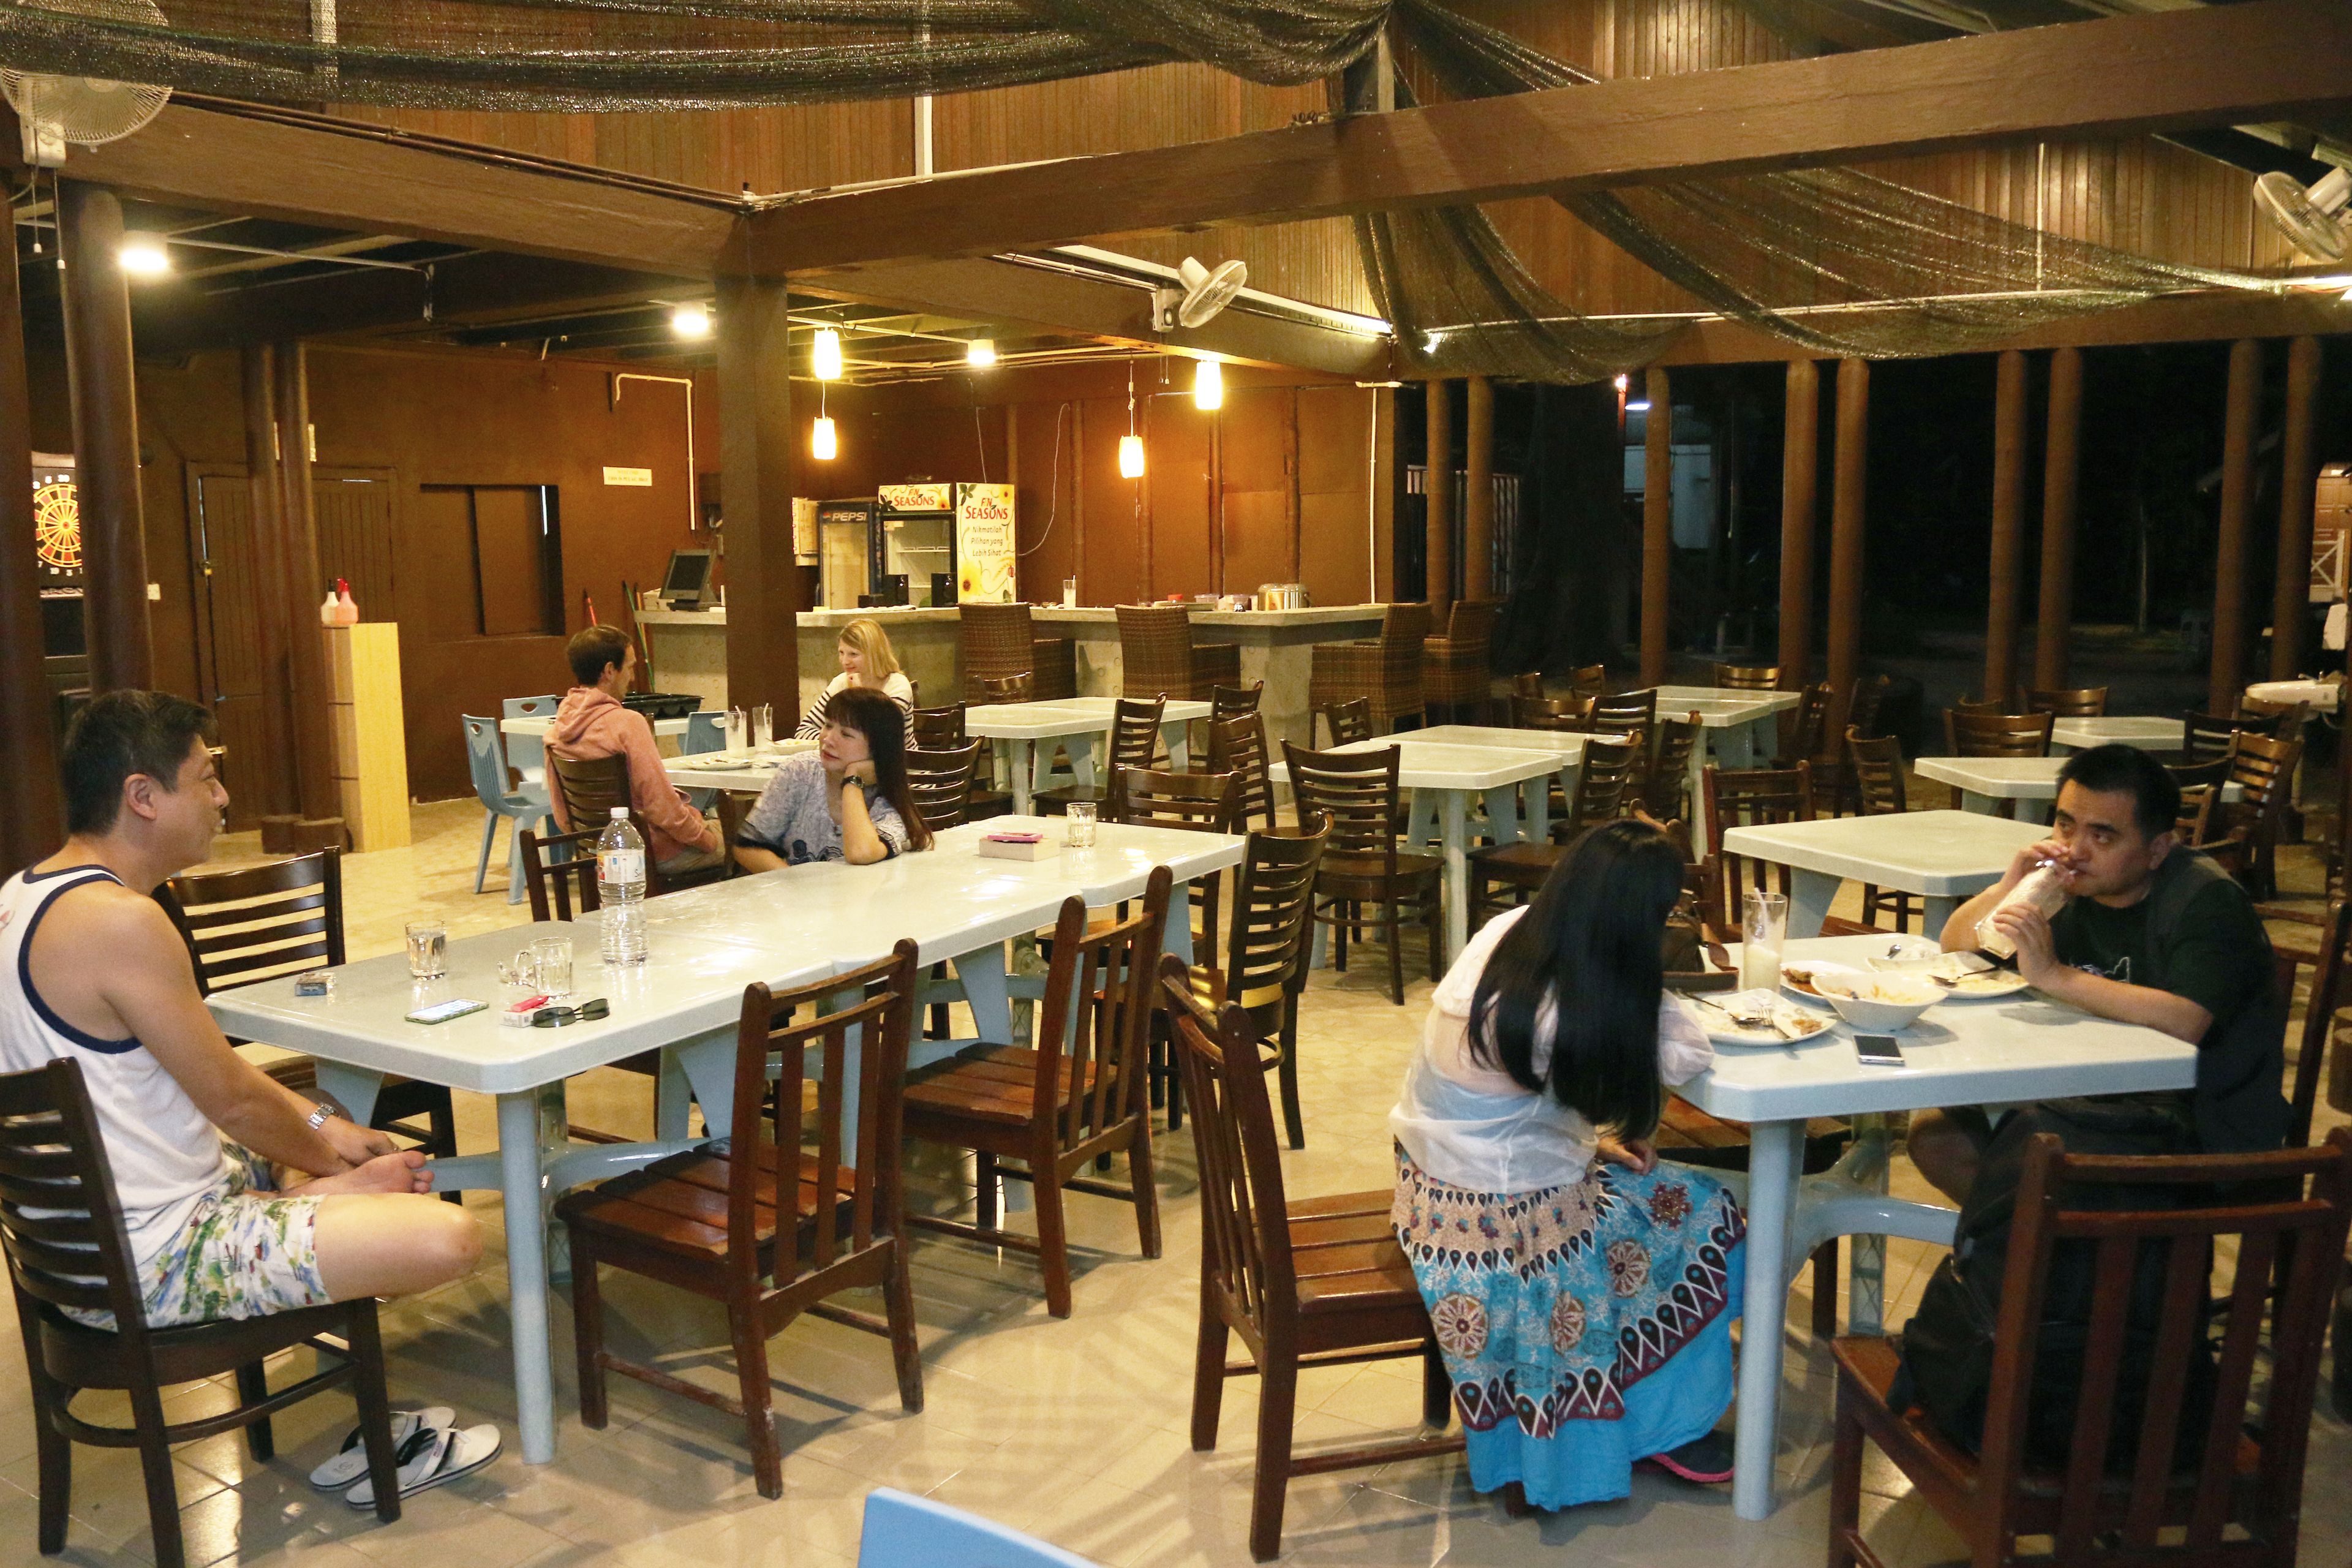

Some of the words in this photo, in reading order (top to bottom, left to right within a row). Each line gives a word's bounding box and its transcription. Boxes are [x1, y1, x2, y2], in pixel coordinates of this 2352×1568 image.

[894, 496, 935, 507] SEASONS
[832, 511, 867, 522] PEPSI
[965, 505, 1008, 519] SEASONS
